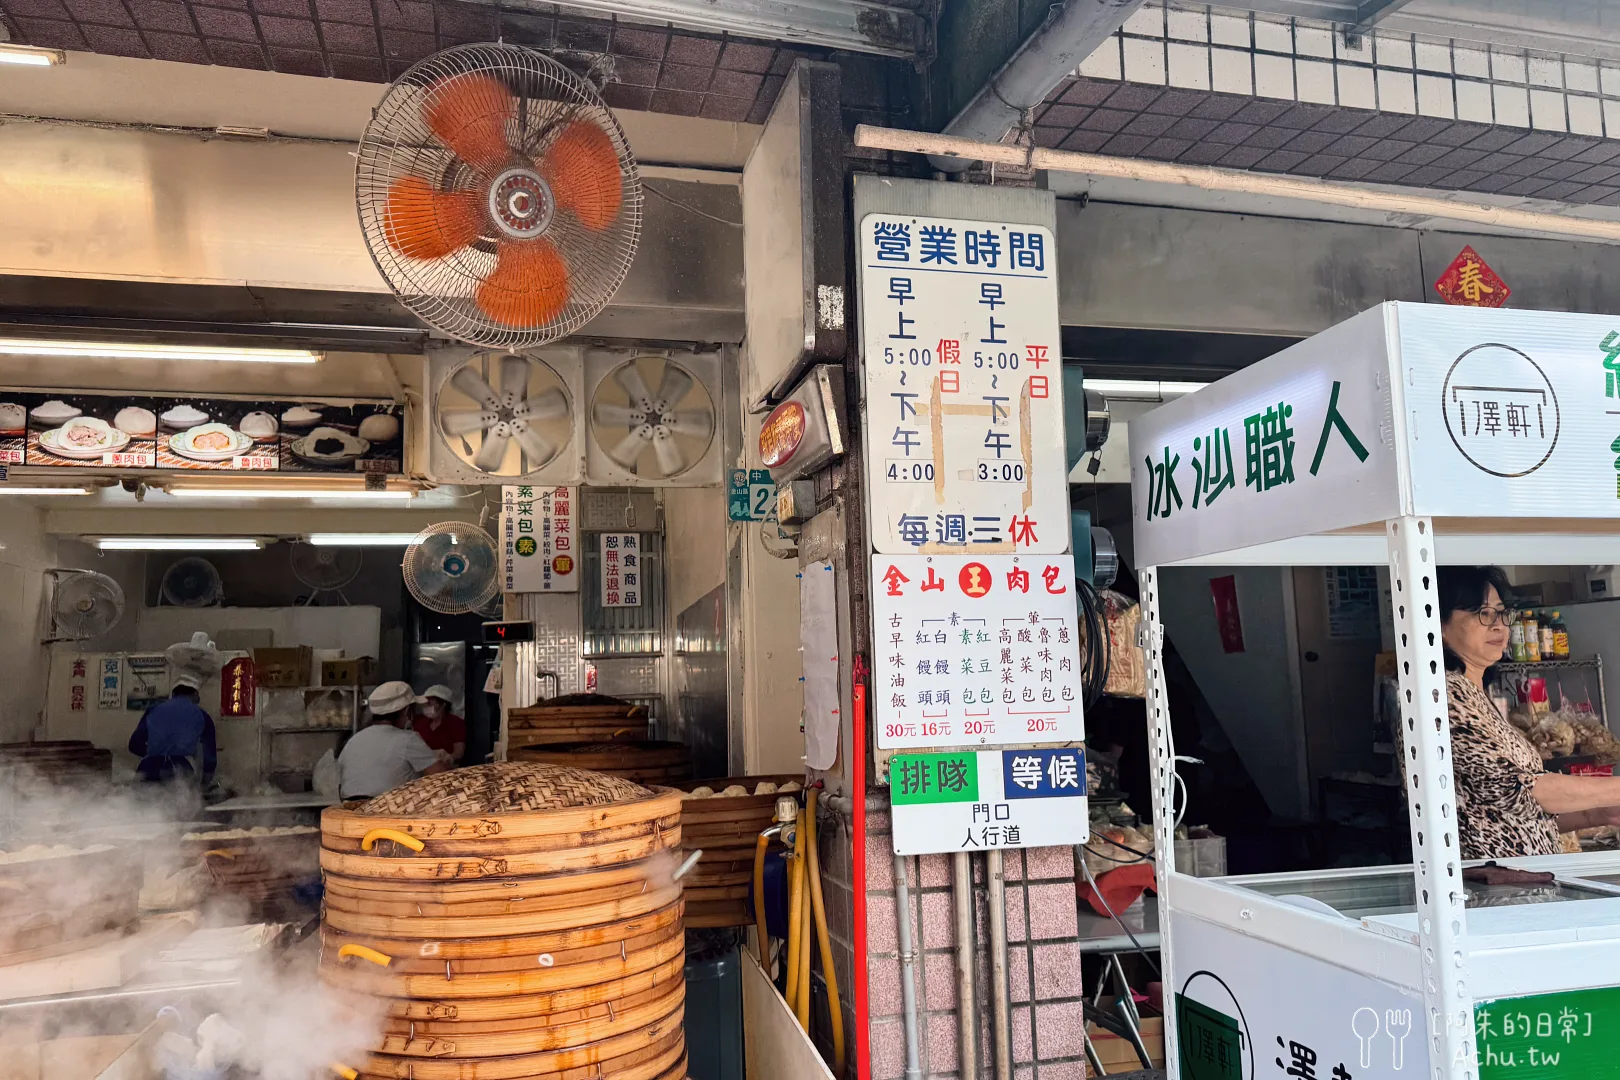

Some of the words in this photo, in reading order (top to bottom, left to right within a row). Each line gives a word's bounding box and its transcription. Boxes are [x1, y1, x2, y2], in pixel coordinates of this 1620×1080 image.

[874, 221, 1045, 272] 營業時間
[1455, 259, 1494, 302] 春
[887, 277, 916, 340] 早上
[978, 282, 1007, 344] 早上
[884, 347, 932, 367] 5:00
[935, 338, 961, 394] 假日
[974, 351, 1019, 370] 5:00
[1025, 344, 1050, 399] 平日
[890, 393, 921, 457] 下午
[982, 396, 1012, 459] 下午
[241, 456, 273, 468] 魯肉包
[887, 462, 935, 482] 4:00
[978, 462, 1024, 482] 3:00
[1144, 380, 1370, 522] 冰沙職人
[517, 485, 534, 533] 素菜包
[554, 485, 571, 551] 高麗菜包
[754, 487, 778, 515] 2
[518, 539, 534, 554] 素
[897, 513, 1039, 547] 每週三休
[605, 535, 620, 605] 恕無法退換
[623, 535, 637, 604] 熟食商品
[881, 562, 1067, 598] 金山王肉包
[947, 611, 961, 627] 素
[888, 612, 908, 709] 古早味油飯
[915, 630, 934, 706] 紅饅頭
[933, 629, 952, 706] 白饅頭
[958, 628, 977, 705] 素菜包
[976, 629, 994, 704] 紅豆包
[998, 627, 1016, 704] 高麗菜包
[1017, 628, 1036, 703] 酸菜包
[1037, 627, 1056, 704] 魯味肉包
[885, 722, 917, 738] 30元
[920, 721, 952, 737] 16元
[964, 719, 996, 736] 20元
[1027, 717, 1058, 733] 20元
[899, 758, 969, 796] 排隊
[1011, 754, 1080, 791] 等候
[960, 824, 1022, 849] 人行道
[972, 803, 1011, 824] 門口
